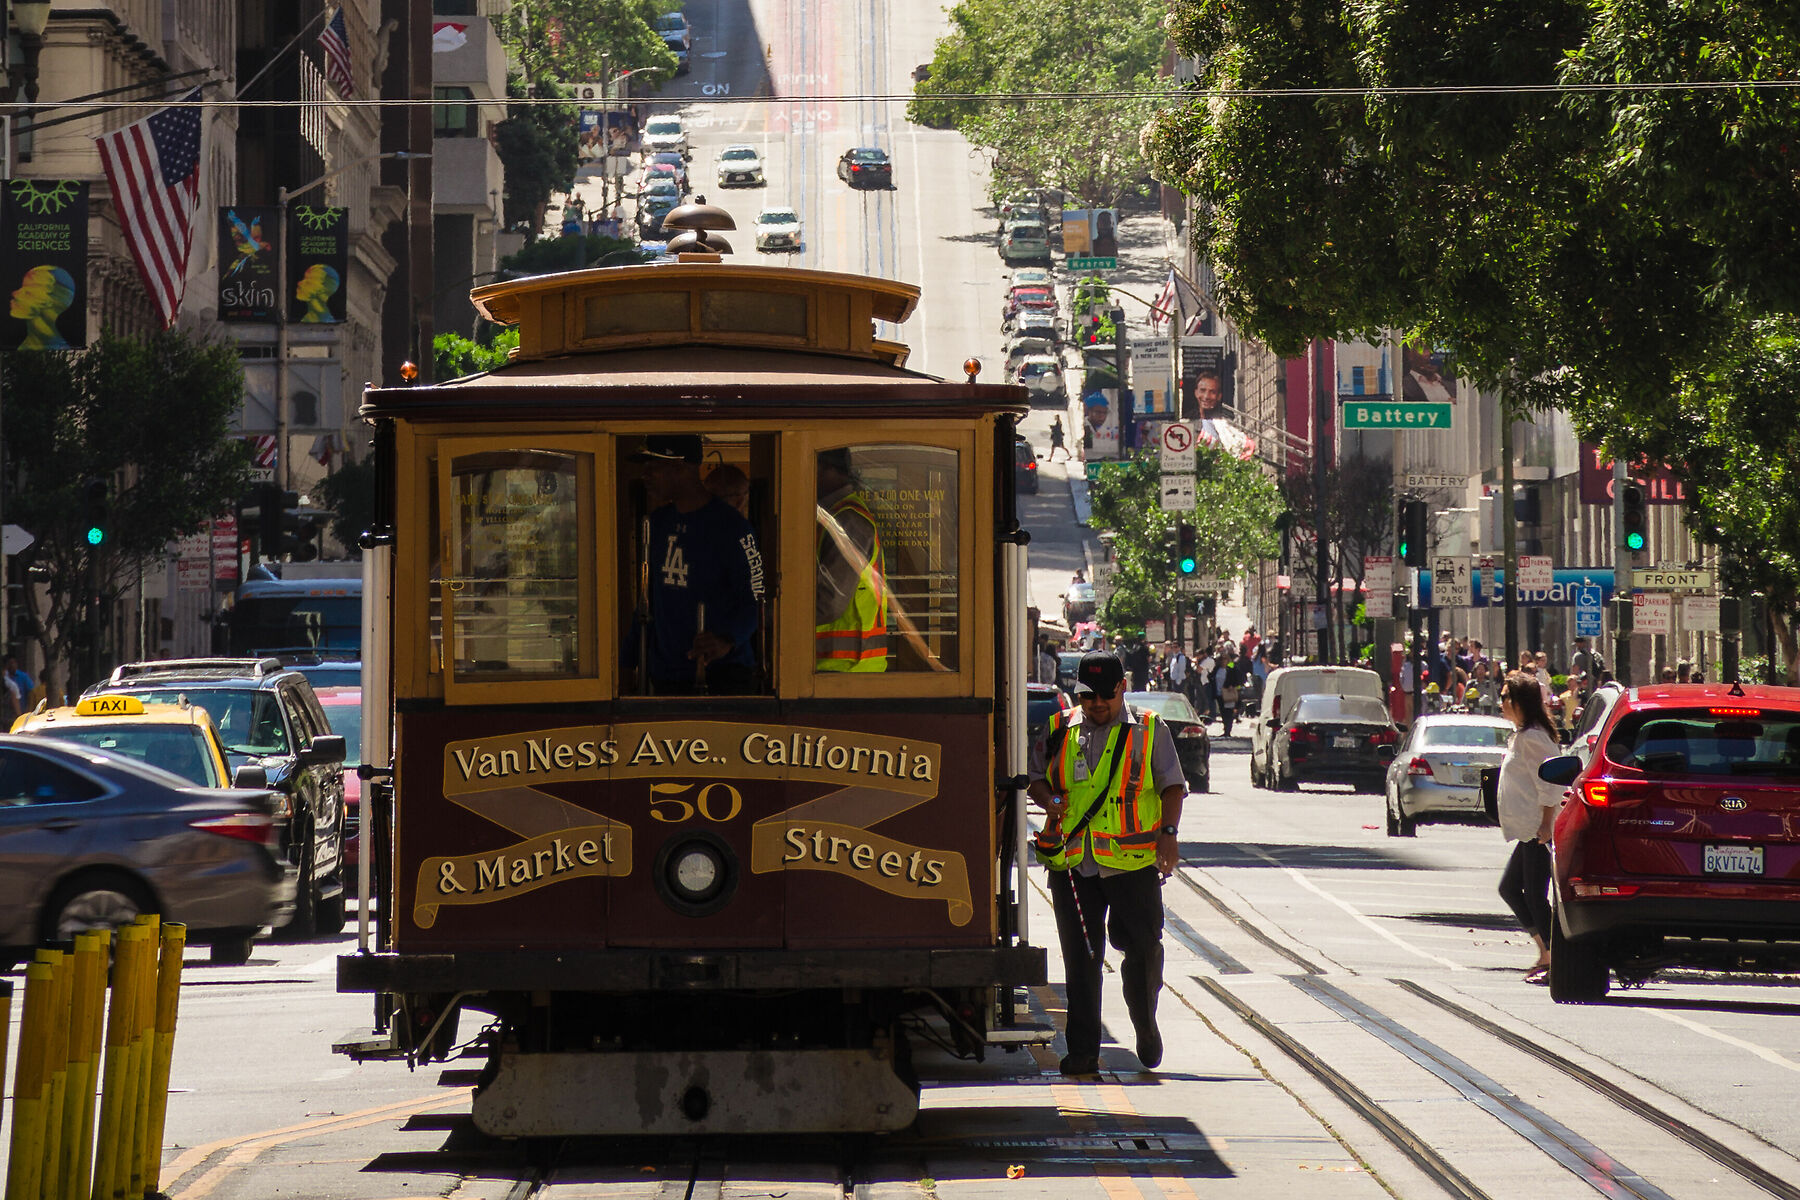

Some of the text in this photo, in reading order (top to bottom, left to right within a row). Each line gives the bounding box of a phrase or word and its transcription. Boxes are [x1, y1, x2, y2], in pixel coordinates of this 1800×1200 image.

[17, 240, 71, 251] SCIENCES
[222, 280, 275, 308] skin
[1357, 408, 1439, 426] Battery
[1408, 476, 1465, 486] BATTERY
[899, 489, 921, 501] ONE
[923, 489, 945, 501] WAY
[661, 535, 688, 587] LA
[1645, 575, 1698, 585] FRONT
[1441, 596, 1463, 604] PASS
[1645, 598, 1669, 606] PARKING
[90, 700, 127, 712] TAXI
[743, 732, 932, 781] California
[650, 782, 742, 823] 50
[1725, 800, 1743, 808] KIA
[439, 828, 945, 893] & Market Streets
[1707, 855, 1761, 872] 8KVT474
